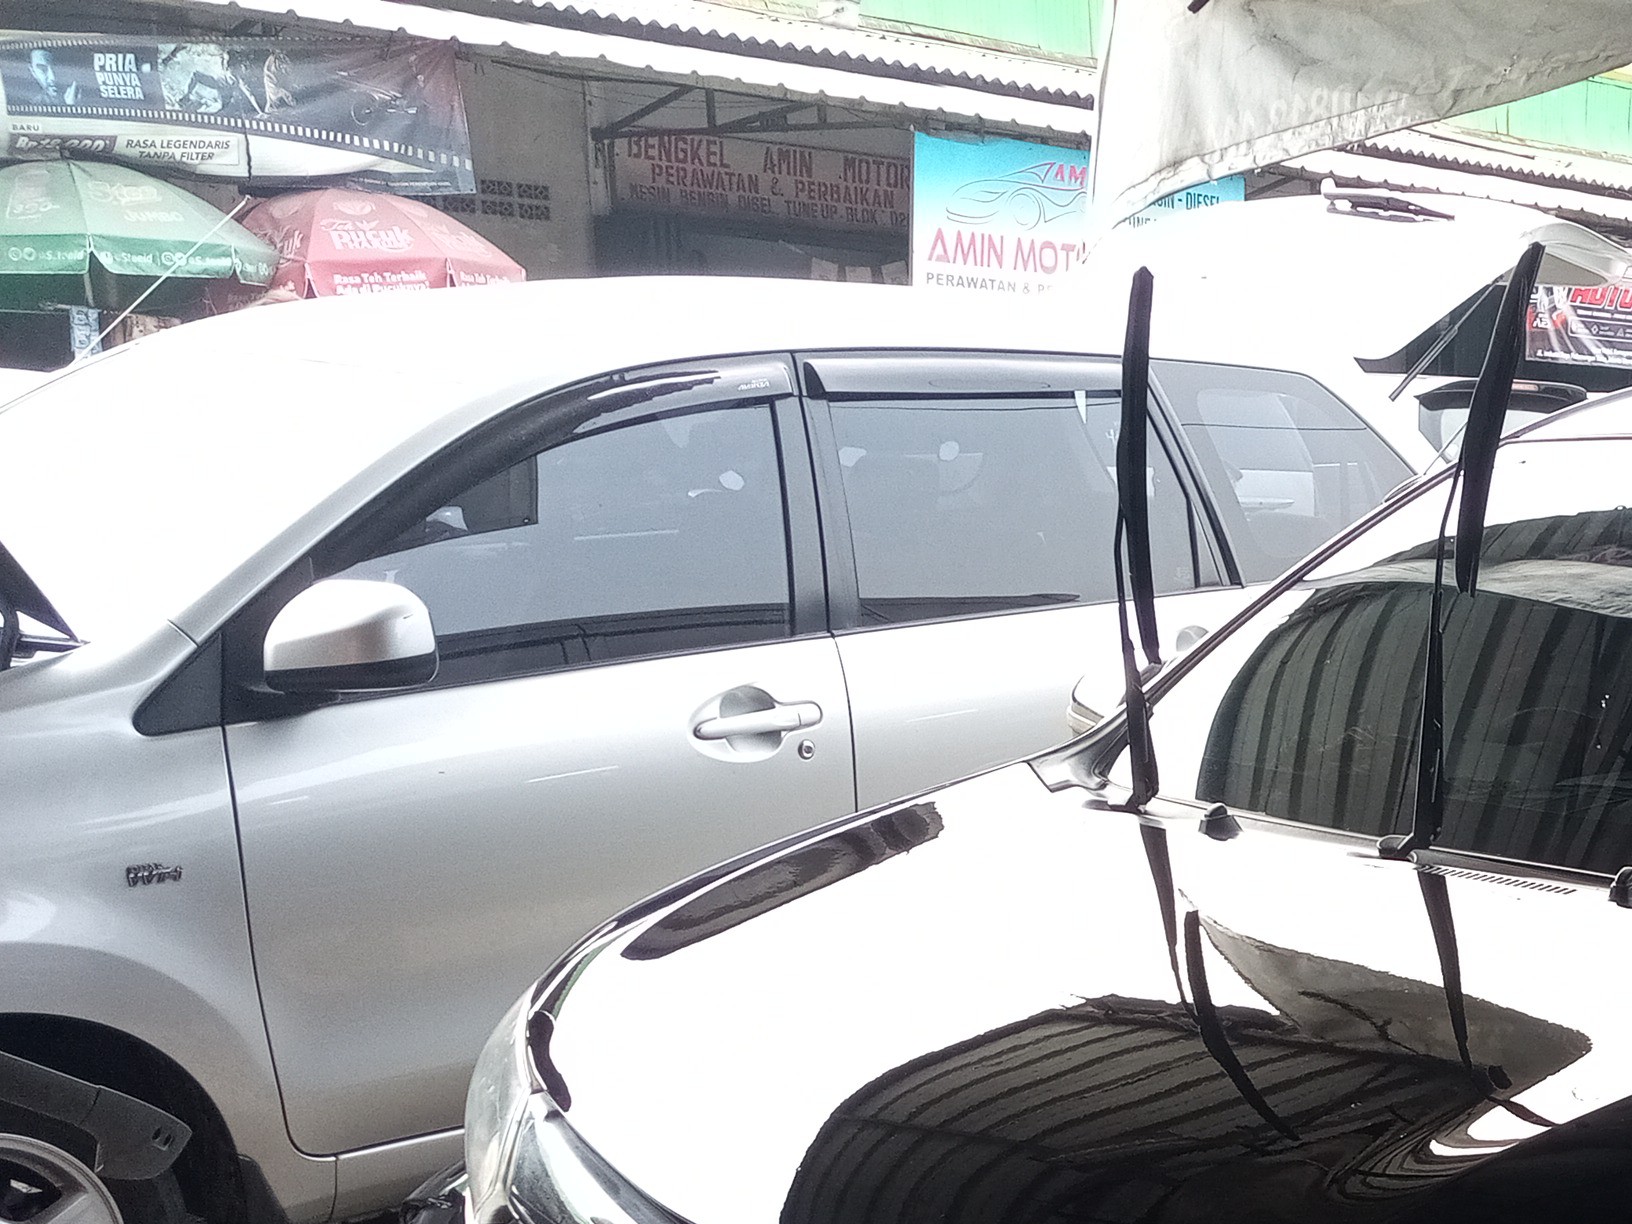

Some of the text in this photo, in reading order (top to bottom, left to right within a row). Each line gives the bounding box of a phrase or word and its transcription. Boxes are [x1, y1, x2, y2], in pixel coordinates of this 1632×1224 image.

[93, 53, 137, 72] PRIA
[96, 72, 142, 87] PUNYA
[100, 85, 145, 100] SELERA
[12, 123, 40, 132] BARU
[125, 138, 231, 150] RASA LEGENDARIS
[138, 150, 216, 162] TANPA FILTER
[626, 134, 911, 191] BENGKEL AMIN MOTOR
[651, 162, 761, 196] PERAWATAN
[793, 178, 895, 210] PERBAIKAN
[927, 226, 1006, 270] AMIN
[361, 272, 383, 284] Teh
[926, 271, 1017, 294] PERAWATAN
